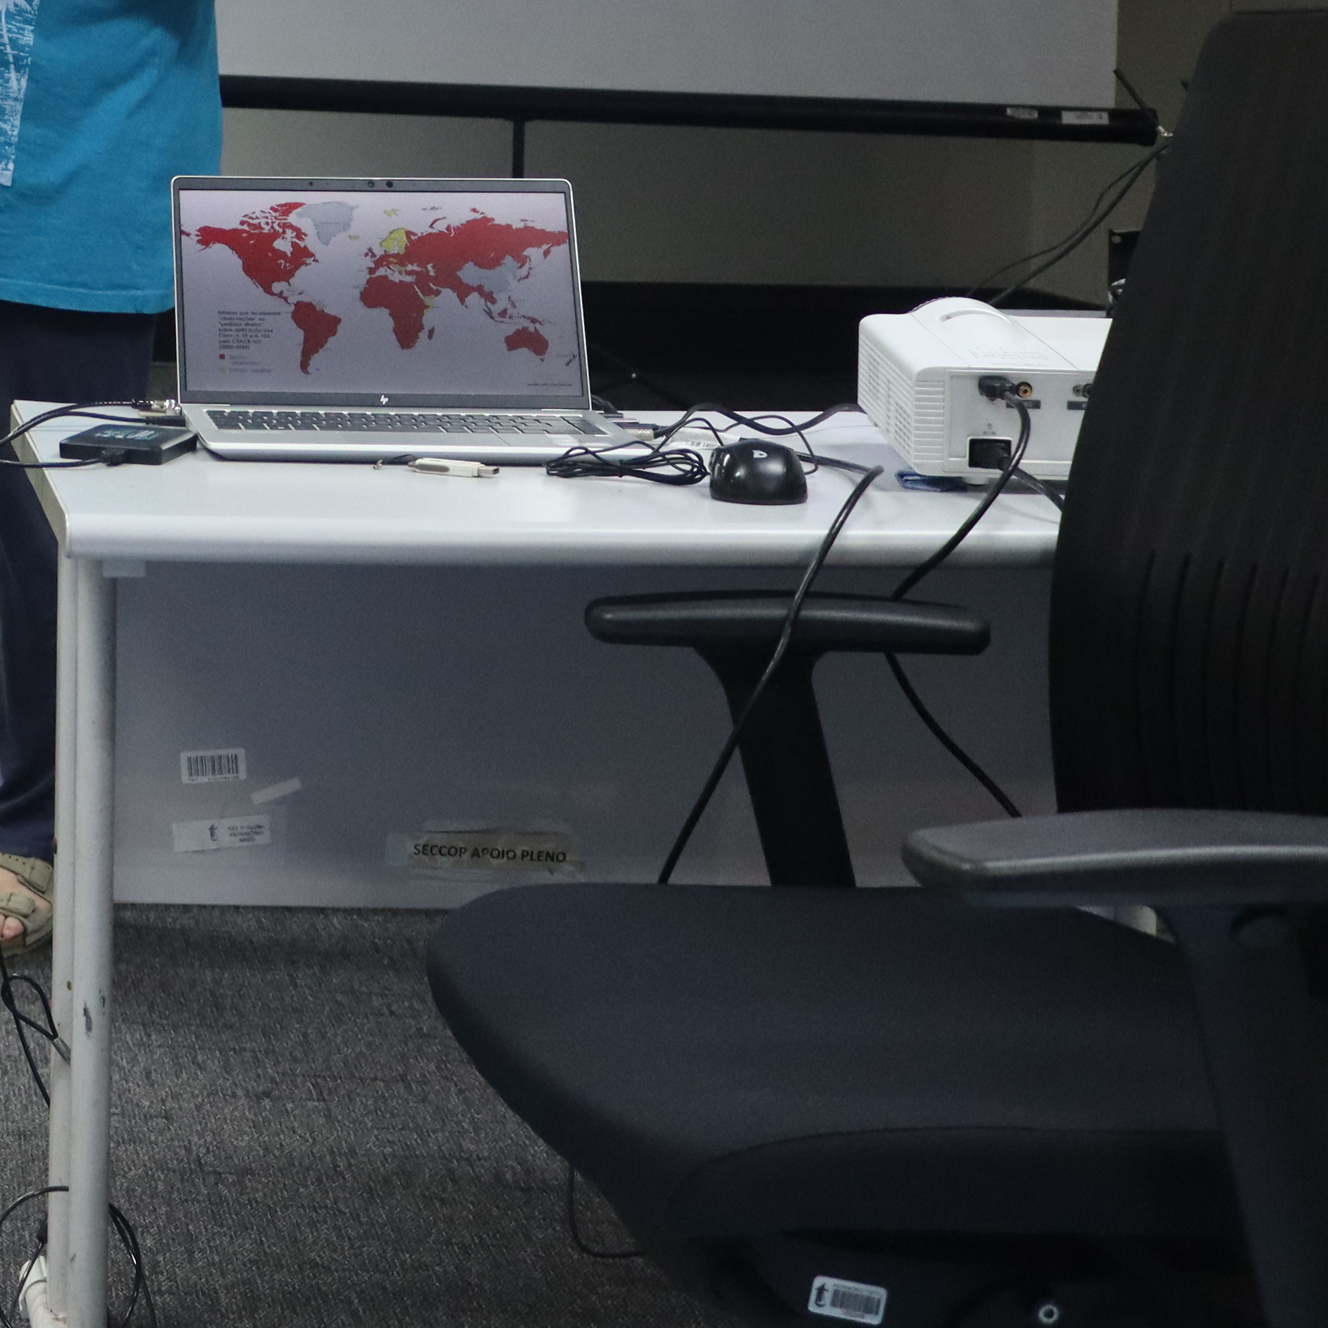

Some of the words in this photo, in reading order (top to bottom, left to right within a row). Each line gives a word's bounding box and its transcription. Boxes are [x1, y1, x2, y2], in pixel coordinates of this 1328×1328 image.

[413, 843, 467, 858] SECCOP
[470, 847, 517, 861] APOIO
[521, 849, 567, 863] PLENO
